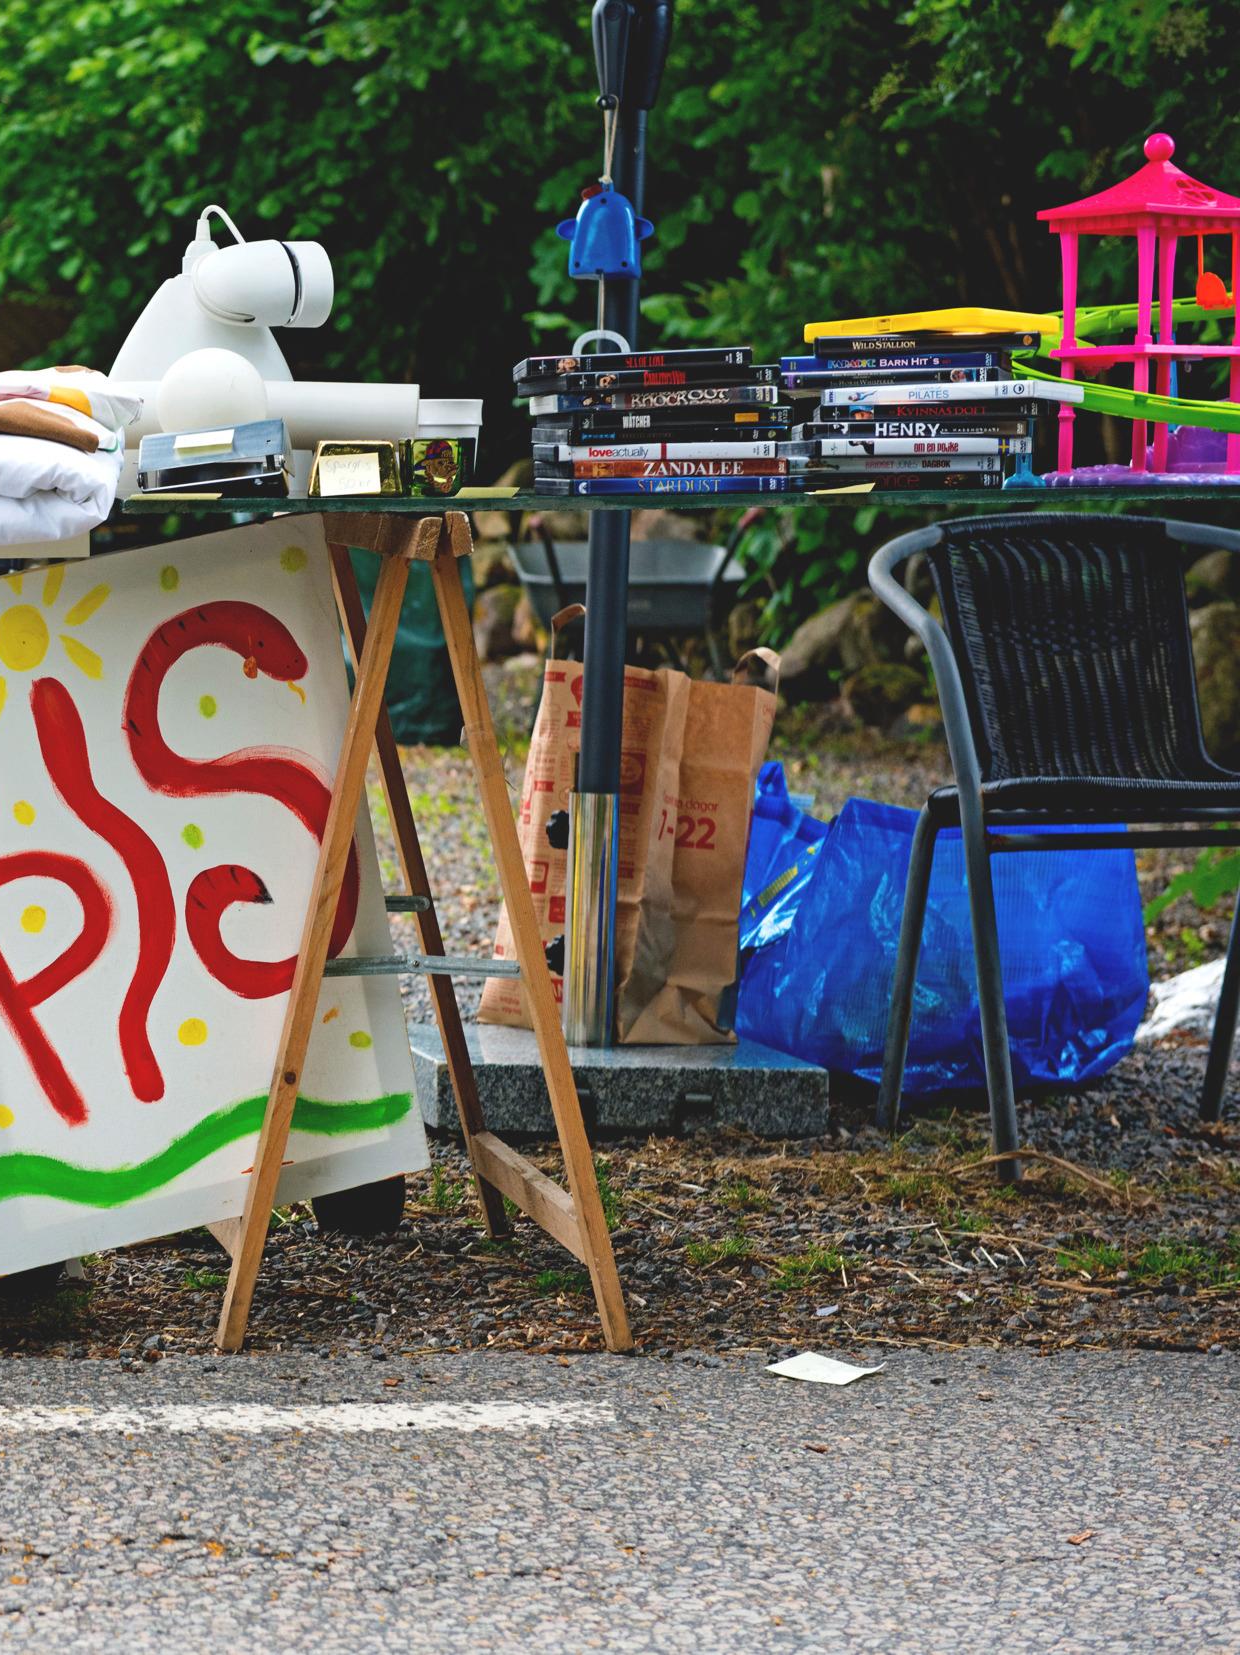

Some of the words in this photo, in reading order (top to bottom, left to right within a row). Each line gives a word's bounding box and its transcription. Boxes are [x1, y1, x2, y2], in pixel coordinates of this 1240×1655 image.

[908, 389, 950, 400] PILATES
[623, 415, 651, 429] WATCHER
[875, 422, 940, 437] HENRY
[643, 460, 745, 477] ZANDALEE
[637, 479, 722, 493] STARDUST
